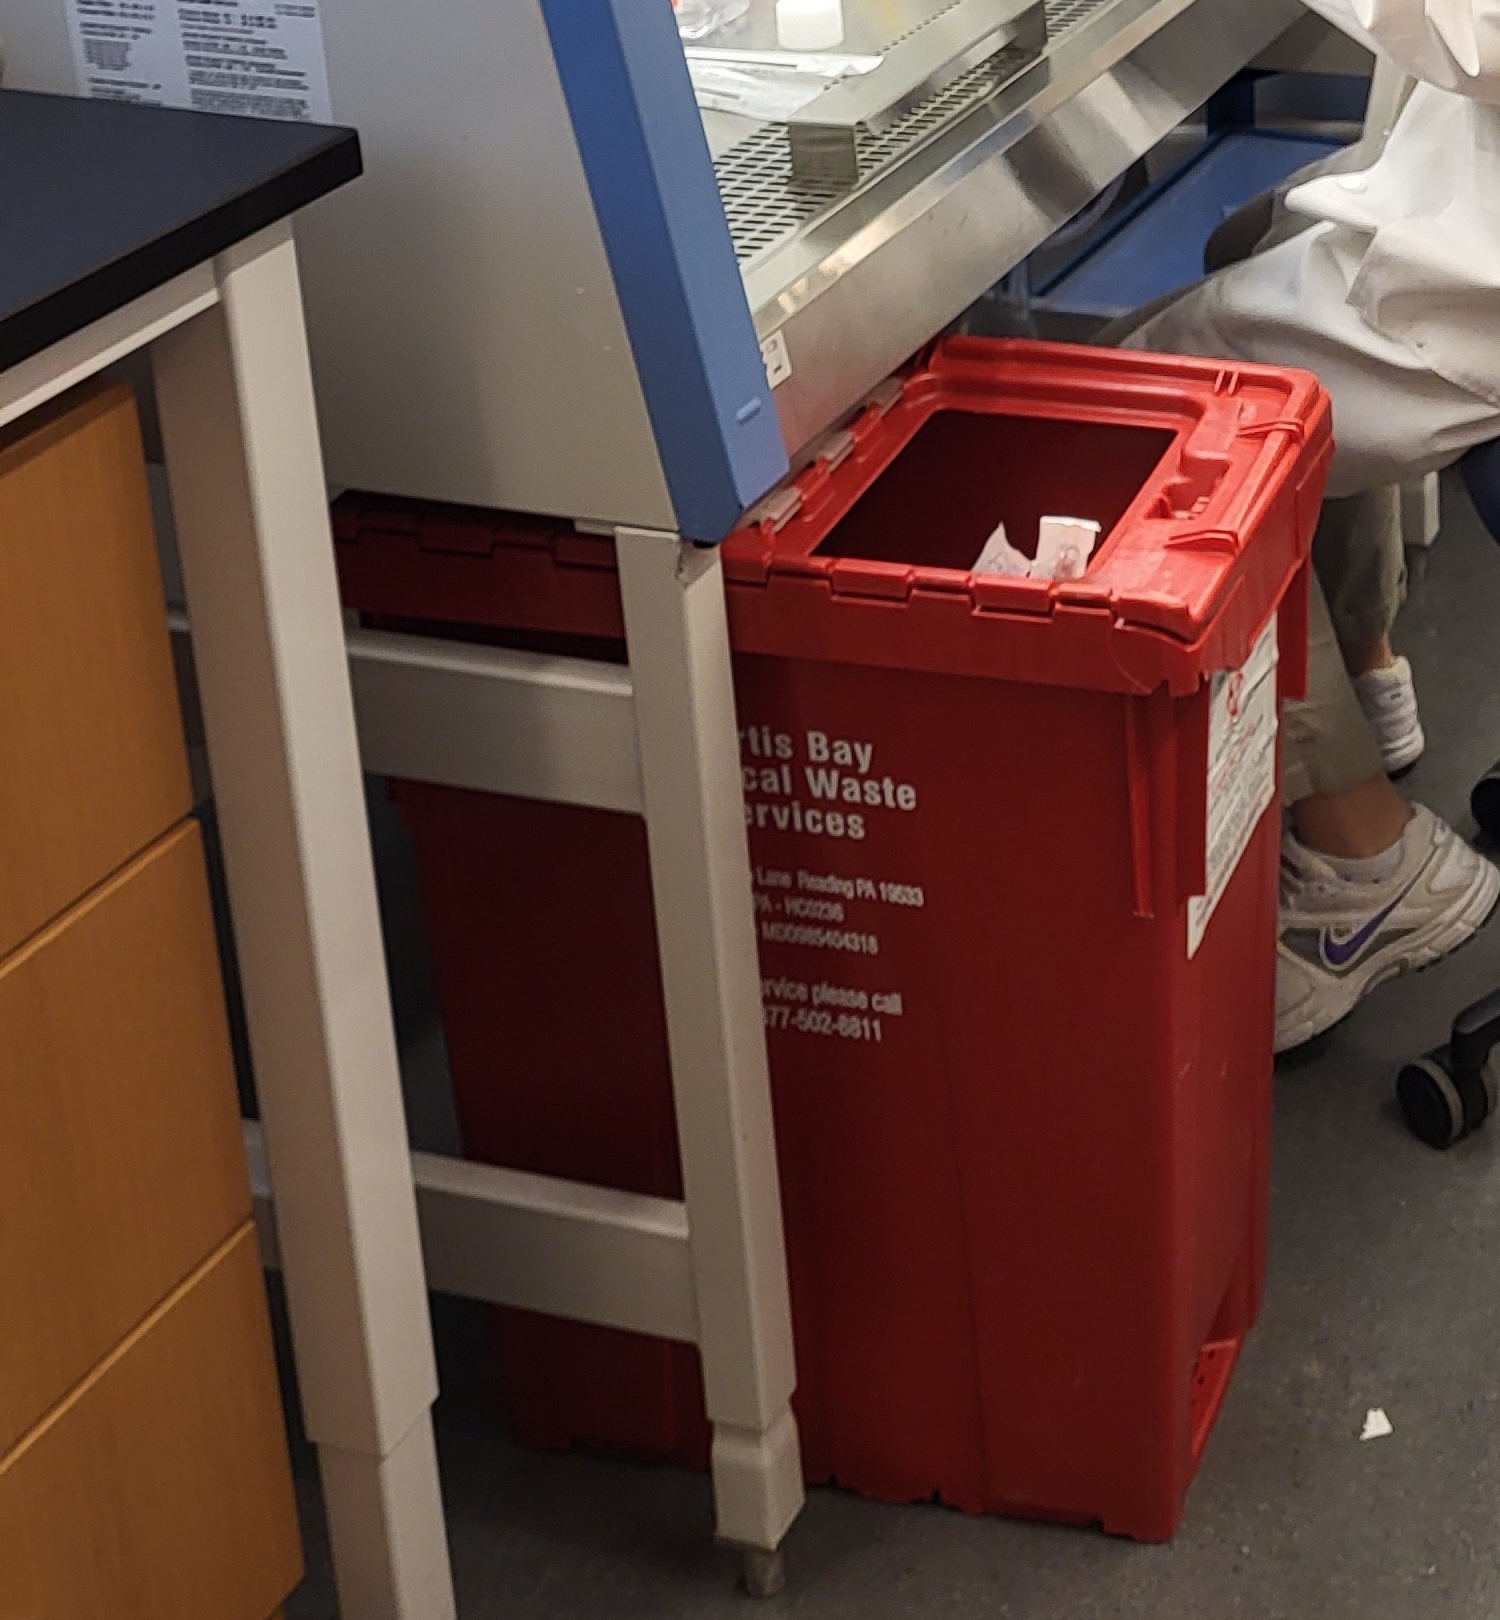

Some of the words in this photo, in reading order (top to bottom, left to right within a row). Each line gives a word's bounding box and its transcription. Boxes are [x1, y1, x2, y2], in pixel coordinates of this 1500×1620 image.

[738, 726, 794, 760] tis
[806, 730, 874, 775] Bay
[805, 767, 917, 811] Waste
[856, 880, 878, 902] PA
[811, 982, 868, 1010] please
[872, 992, 902, 1016] call
